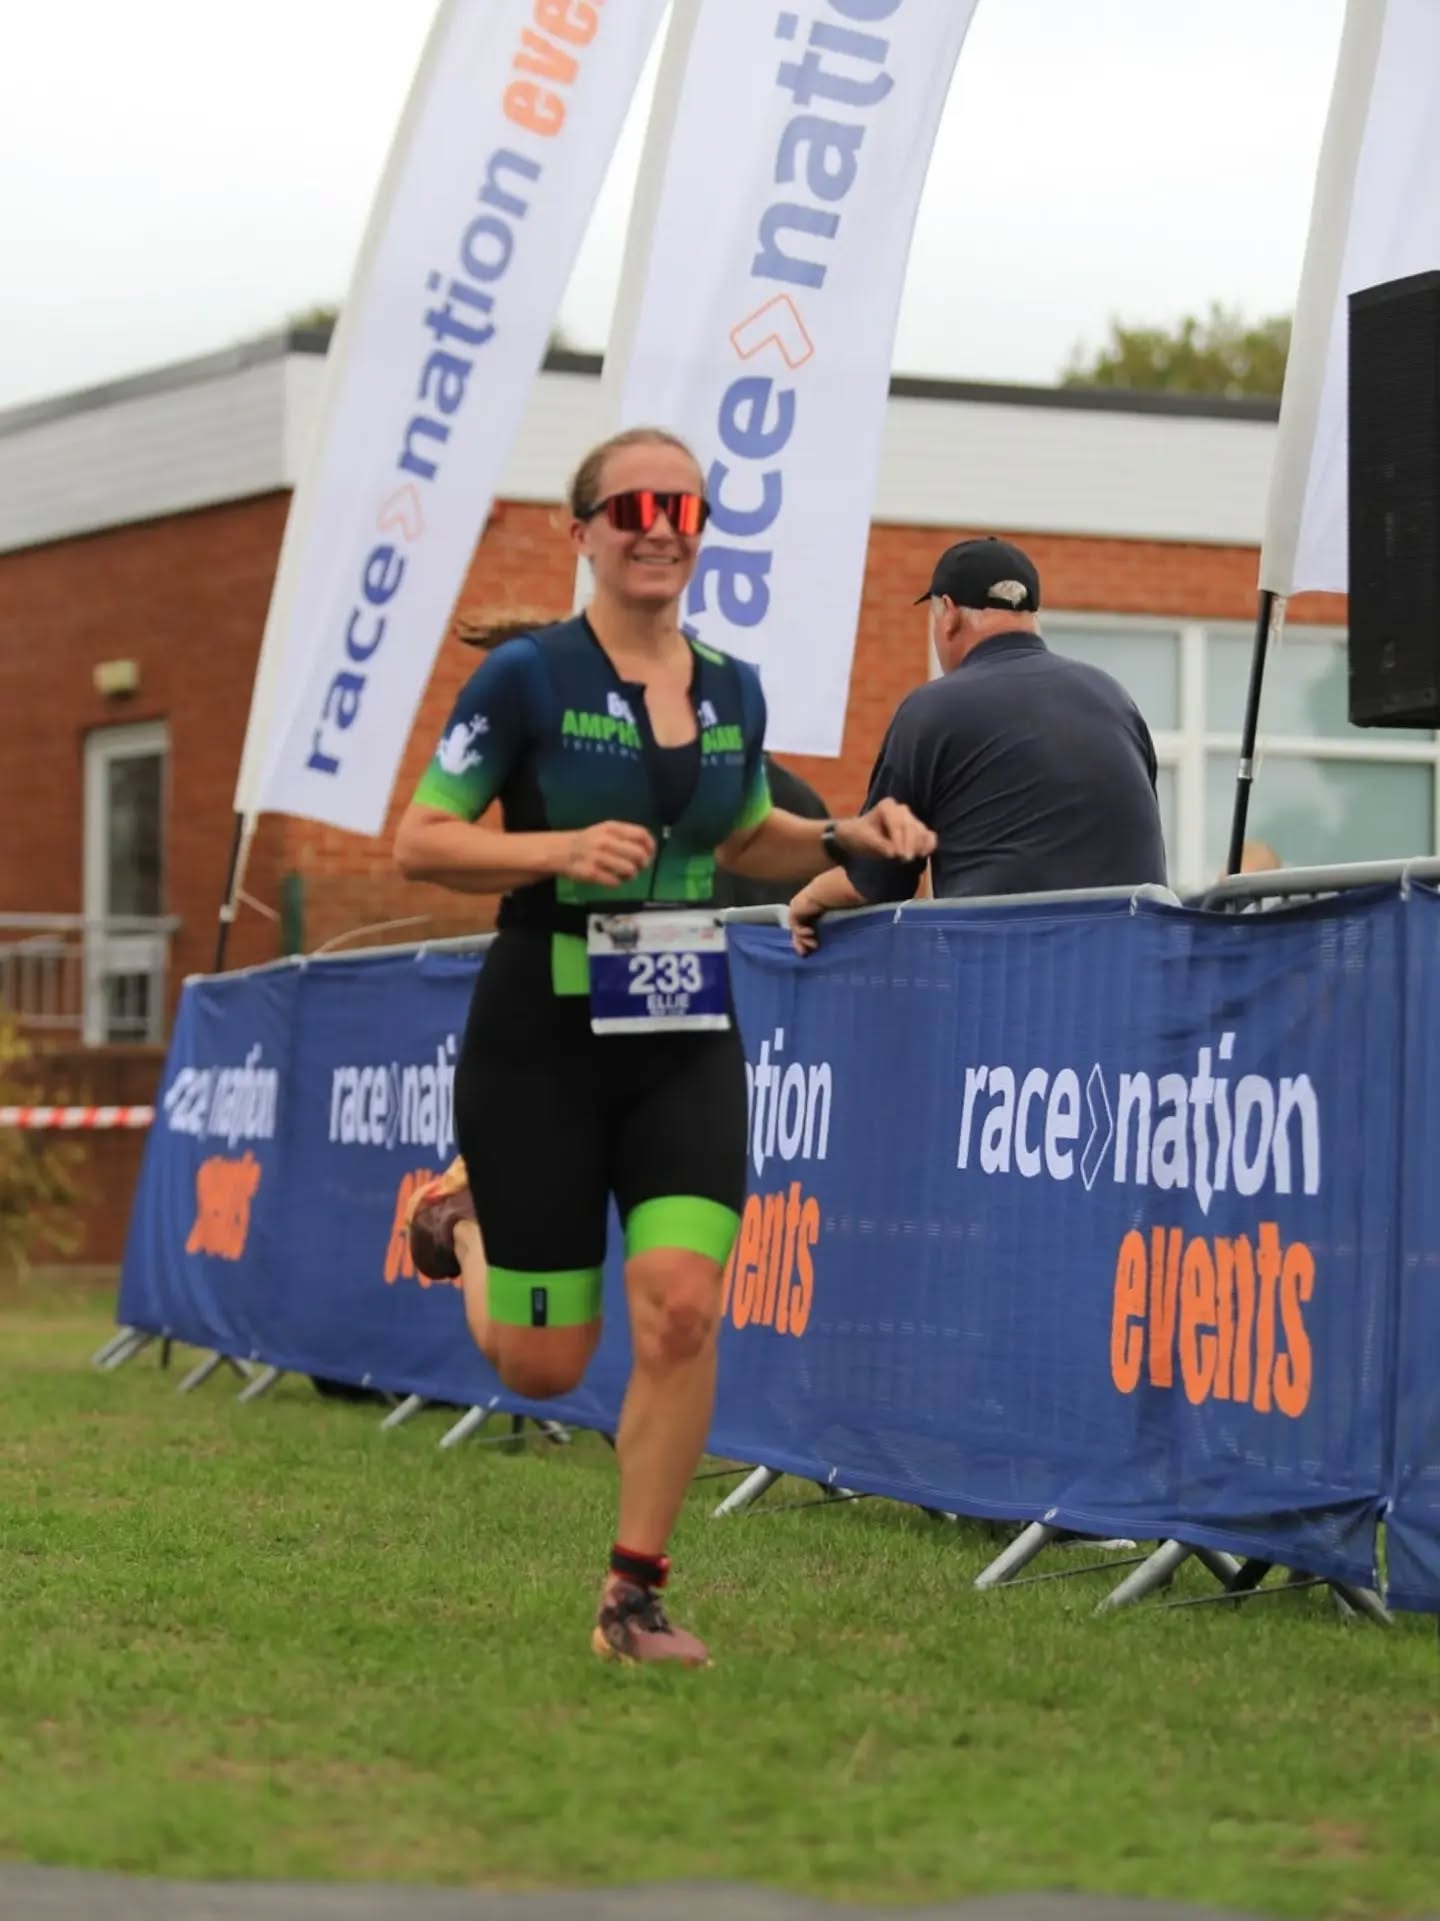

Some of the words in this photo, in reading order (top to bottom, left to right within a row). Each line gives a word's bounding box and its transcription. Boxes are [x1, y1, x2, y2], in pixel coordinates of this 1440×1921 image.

[306, 544, 407, 776] race
[398, 147, 543, 482] nation
[502, 0, 600, 137] eve
[682, 375, 797, 640] ace
[754, 0, 903, 289] nati
[628, 953, 704, 995] 233
[328, 1064, 388, 1145] race
[956, 1064, 1081, 1182] race
[1112, 1032, 1320, 1217] nation
[1110, 1222, 1315, 1418] events
